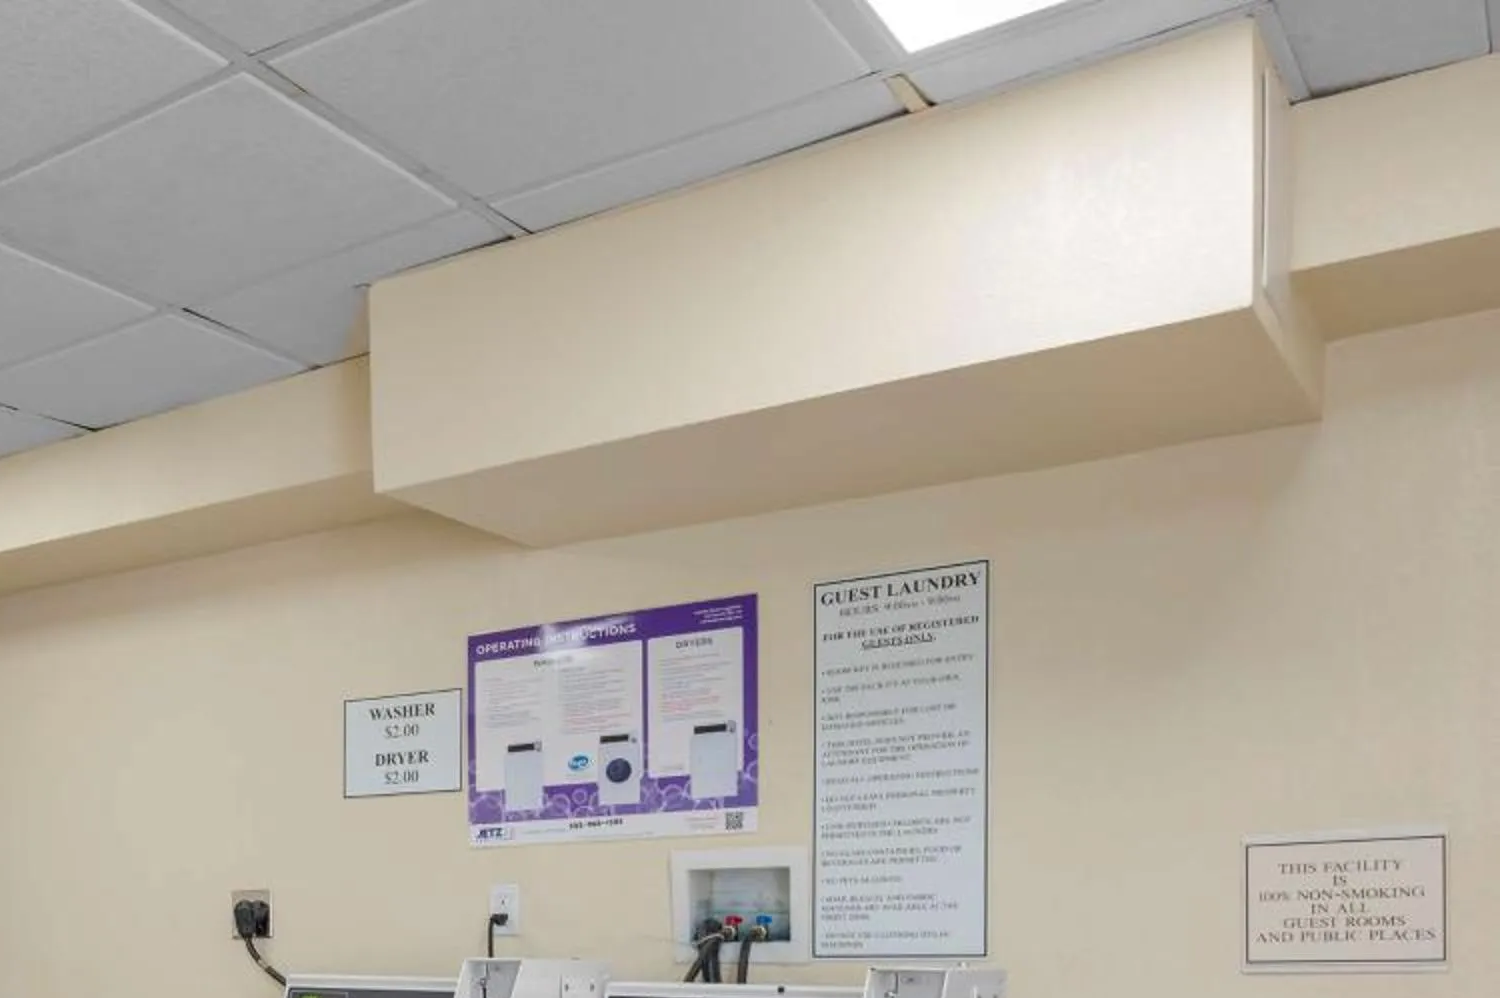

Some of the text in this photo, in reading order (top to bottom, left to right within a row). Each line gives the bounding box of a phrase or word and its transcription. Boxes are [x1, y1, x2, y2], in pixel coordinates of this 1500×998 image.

[821, 571, 980, 606] GUEST LAUNDRY
[475, 637, 541, 655] OPERATING
[369, 702, 436, 720] WASHER
[384, 723, 420, 738] $2.00
[375, 749, 429, 767] DRYER
[384, 769, 420, 785] $2.00
[1278, 858, 1402, 875] THIS FACILITY
[1332, 875, 1348, 887] IS
[1258, 885, 1425, 903] 100% NON-SMOKING
[1310, 902, 1371, 915] IN ALL
[1283, 915, 1407, 929] GUEST ROOMS
[1255, 927, 1437, 944] AND PUBLIC PLACES
